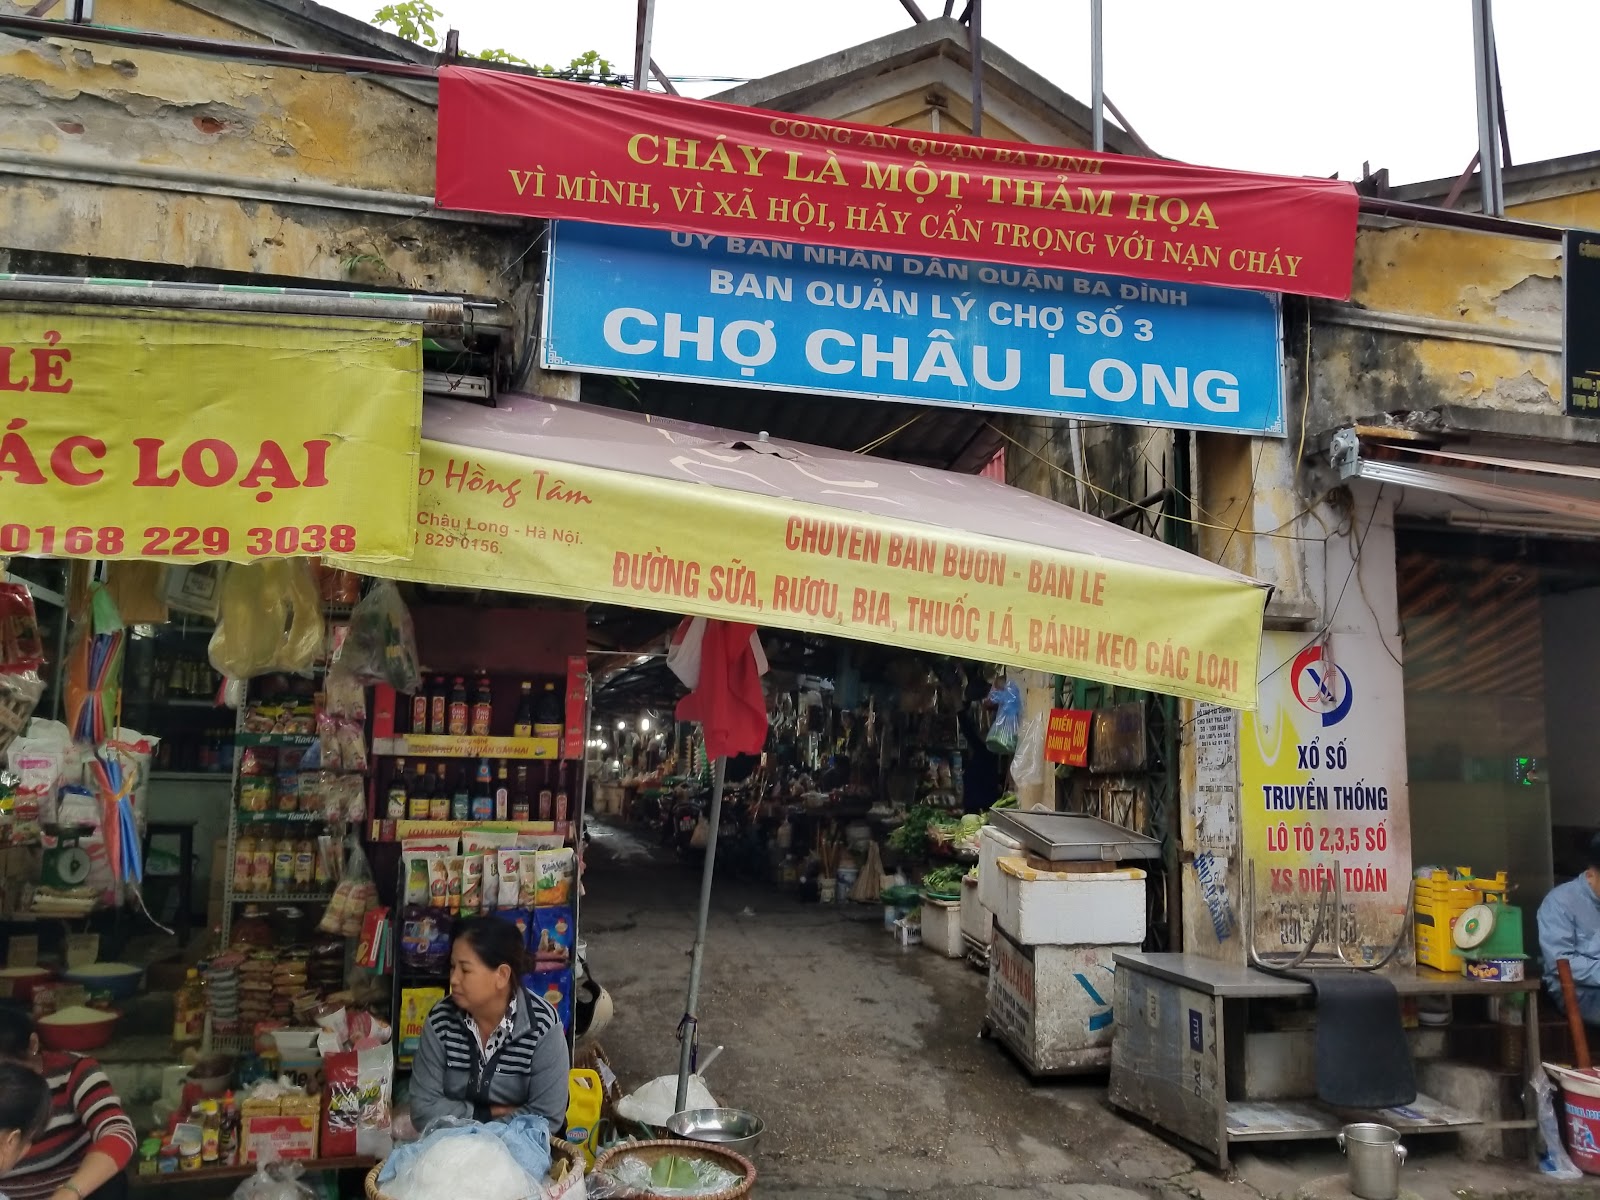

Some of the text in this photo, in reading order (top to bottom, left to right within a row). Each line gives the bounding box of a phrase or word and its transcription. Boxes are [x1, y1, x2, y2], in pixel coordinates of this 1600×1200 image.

[859, 132, 901, 149] AN
[991, 148, 1028, 167] BA
[627, 133, 1220, 233] CHÁY LÀ MỘT THẢM HỌA
[509, 164, 1303, 278] VÌ MÌNH, VÌ XÃ HỘI, HÃY CẨN TRỌNG VỚI NẠN CHÁY
[727, 236, 793, 260] BAN
[804, 244, 893, 272] NHÂN
[903, 257, 969, 281] DÂN
[978, 265, 1064, 293] QUẬN
[1073, 278, 1112, 297] BA
[1120, 281, 1188, 306] ĐÌNH
[709, 269, 1153, 342] BAN QUẢN LÝ CHỢ SỐ 3
[0, 330, 73, 394] LẺ
[603, 307, 1240, 413] CHỢ CHÂU LONG
[132, 437, 332, 503] LOẠI
[445, 459, 521, 508] Hồng
[533, 470, 592, 505] Tâm
[1, 523, 357, 556] 0168 229 3038
[417, 511, 460, 528] Châu
[467, 518, 508, 537] Long
[526, 525, 546, 540] Hà
[425, 533, 454, 547] 829
[613, 546, 700, 599] ĐƯỜNG
[708, 558, 764, 612] SỮA,
[851, 587, 897, 632] BIA,
[907, 593, 980, 642] THUỐC
[987, 606, 1020, 653] LÁ,
[1029, 615, 1090, 661] BÁNH
[1095, 631, 1138, 675] KẸO
[1145, 637, 1190, 680] CÁC
[1195, 650, 1240, 697] LOẠI
[1297, 736, 1347, 770] XỔ SỐ
[1263, 778, 1388, 811] TRUYỀN THỐNG
[1267, 819, 1387, 854] LÔ TÔ 2,3,5 SỐ
[1271, 869, 1293, 894] XS
[1344, 862, 1387, 893] TOÁN
